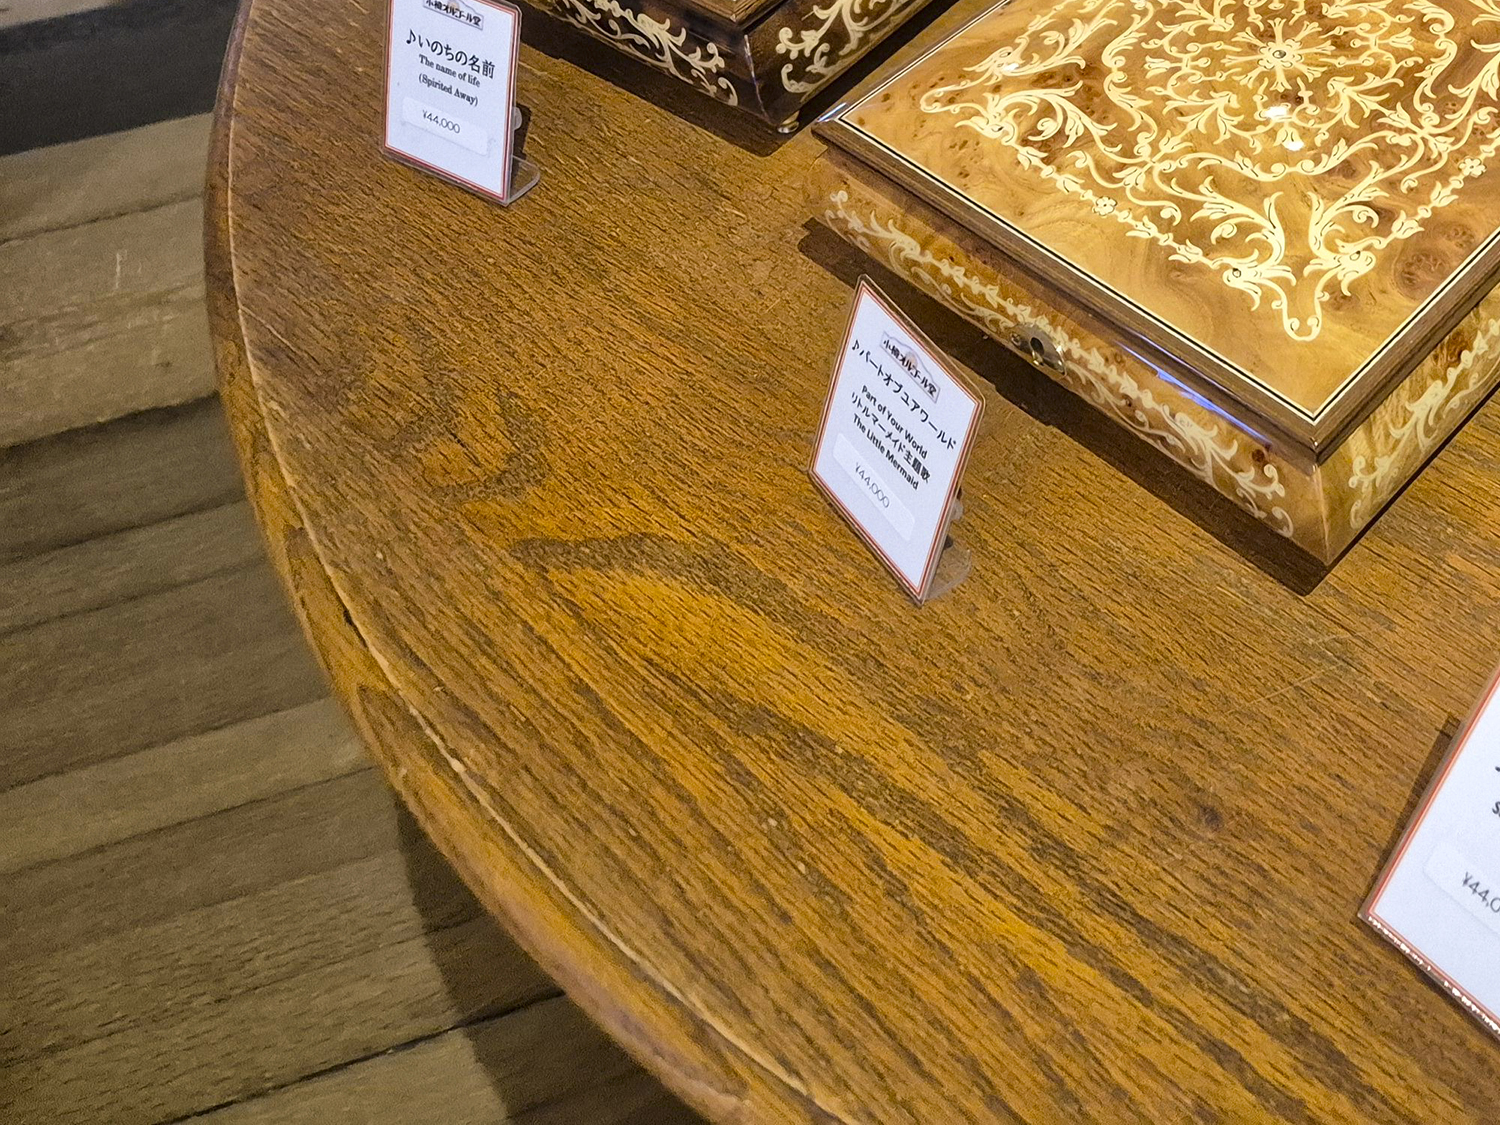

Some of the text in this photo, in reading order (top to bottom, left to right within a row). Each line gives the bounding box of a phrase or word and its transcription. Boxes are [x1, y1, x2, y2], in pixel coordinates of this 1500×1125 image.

[418, 73, 479, 107] (Spirited Away)
[419, 53, 481, 88] The name of life
[422, 109, 460, 134] ¥44,000
[852, 392, 931, 484] リトルマーメイド主題歌
[862, 385, 928, 459] Part of Your World
[854, 413, 919, 490] The Little Mermaid
